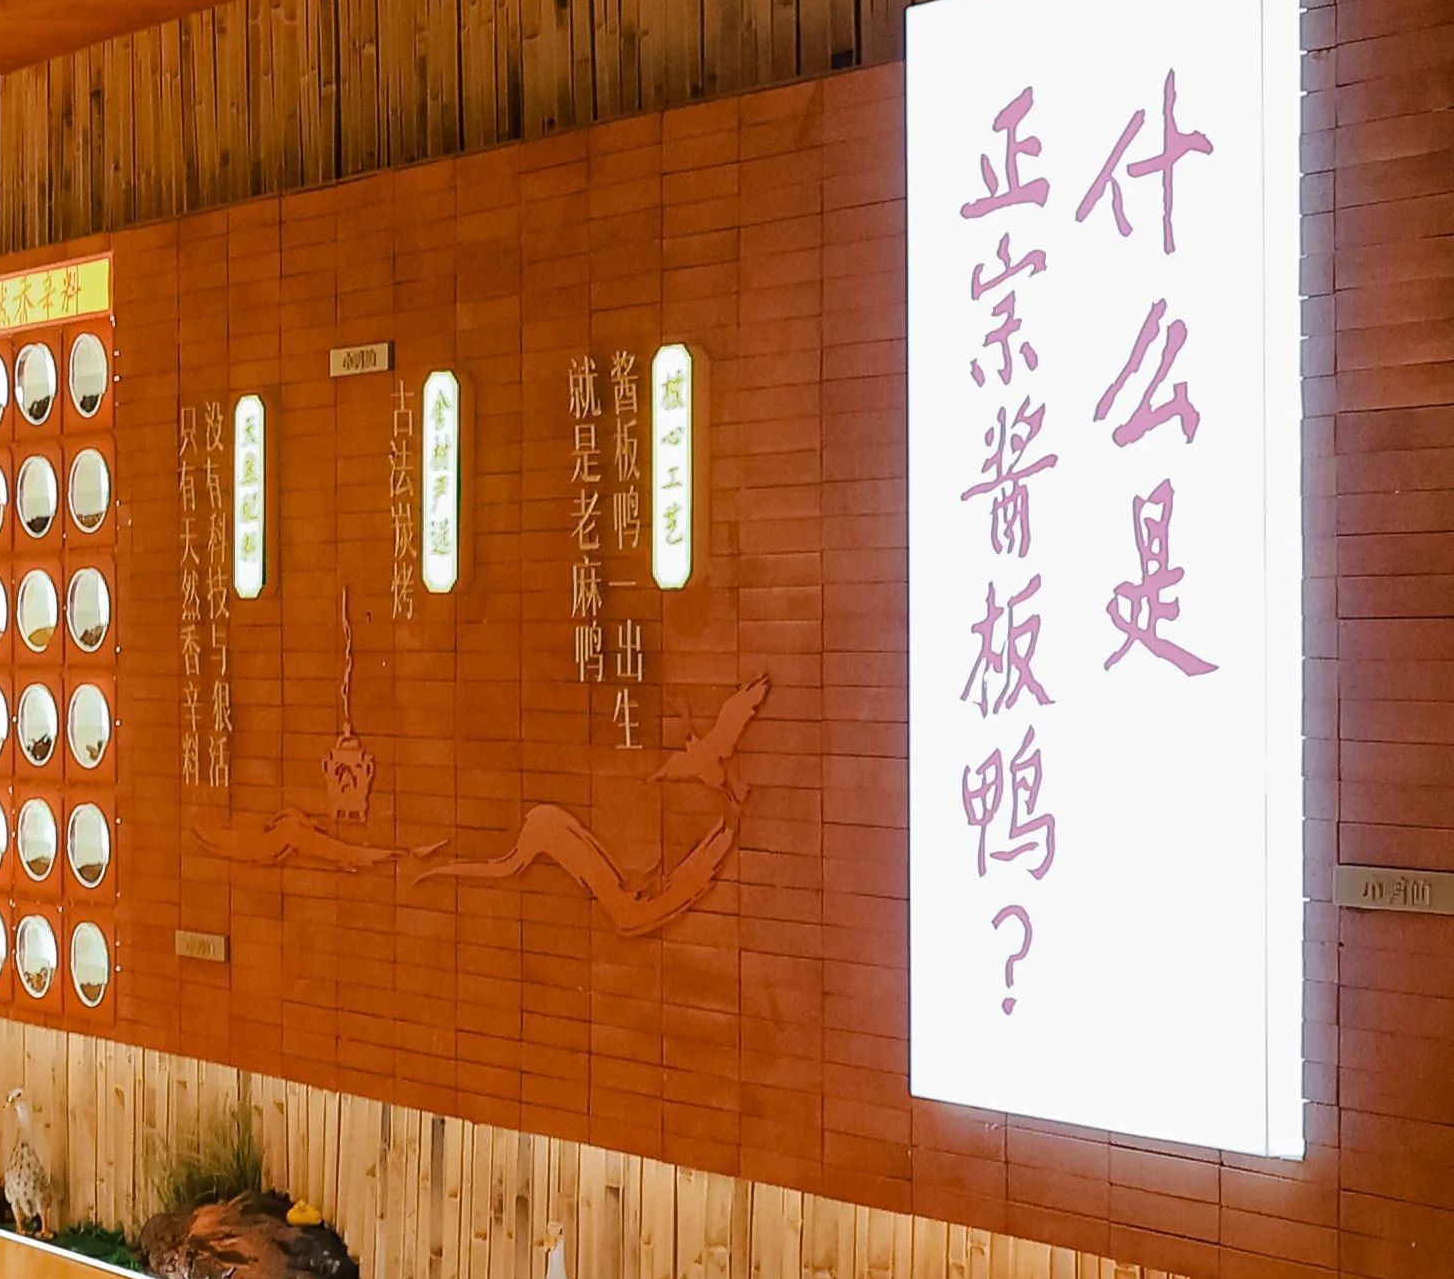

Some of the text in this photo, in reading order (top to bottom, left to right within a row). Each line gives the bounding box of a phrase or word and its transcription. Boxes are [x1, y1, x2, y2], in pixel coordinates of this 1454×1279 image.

[389, 381, 416, 620] 古法炭烤
[568, 357, 604, 683] 就是老麻鸭
[610, 350, 643, 750] 酱板鸭一出生
[1076, 68, 1220, 678] 什么是
[178, 406, 202, 785] 只有天然香辛料
[205, 403, 232, 788] 没有科技与狠活
